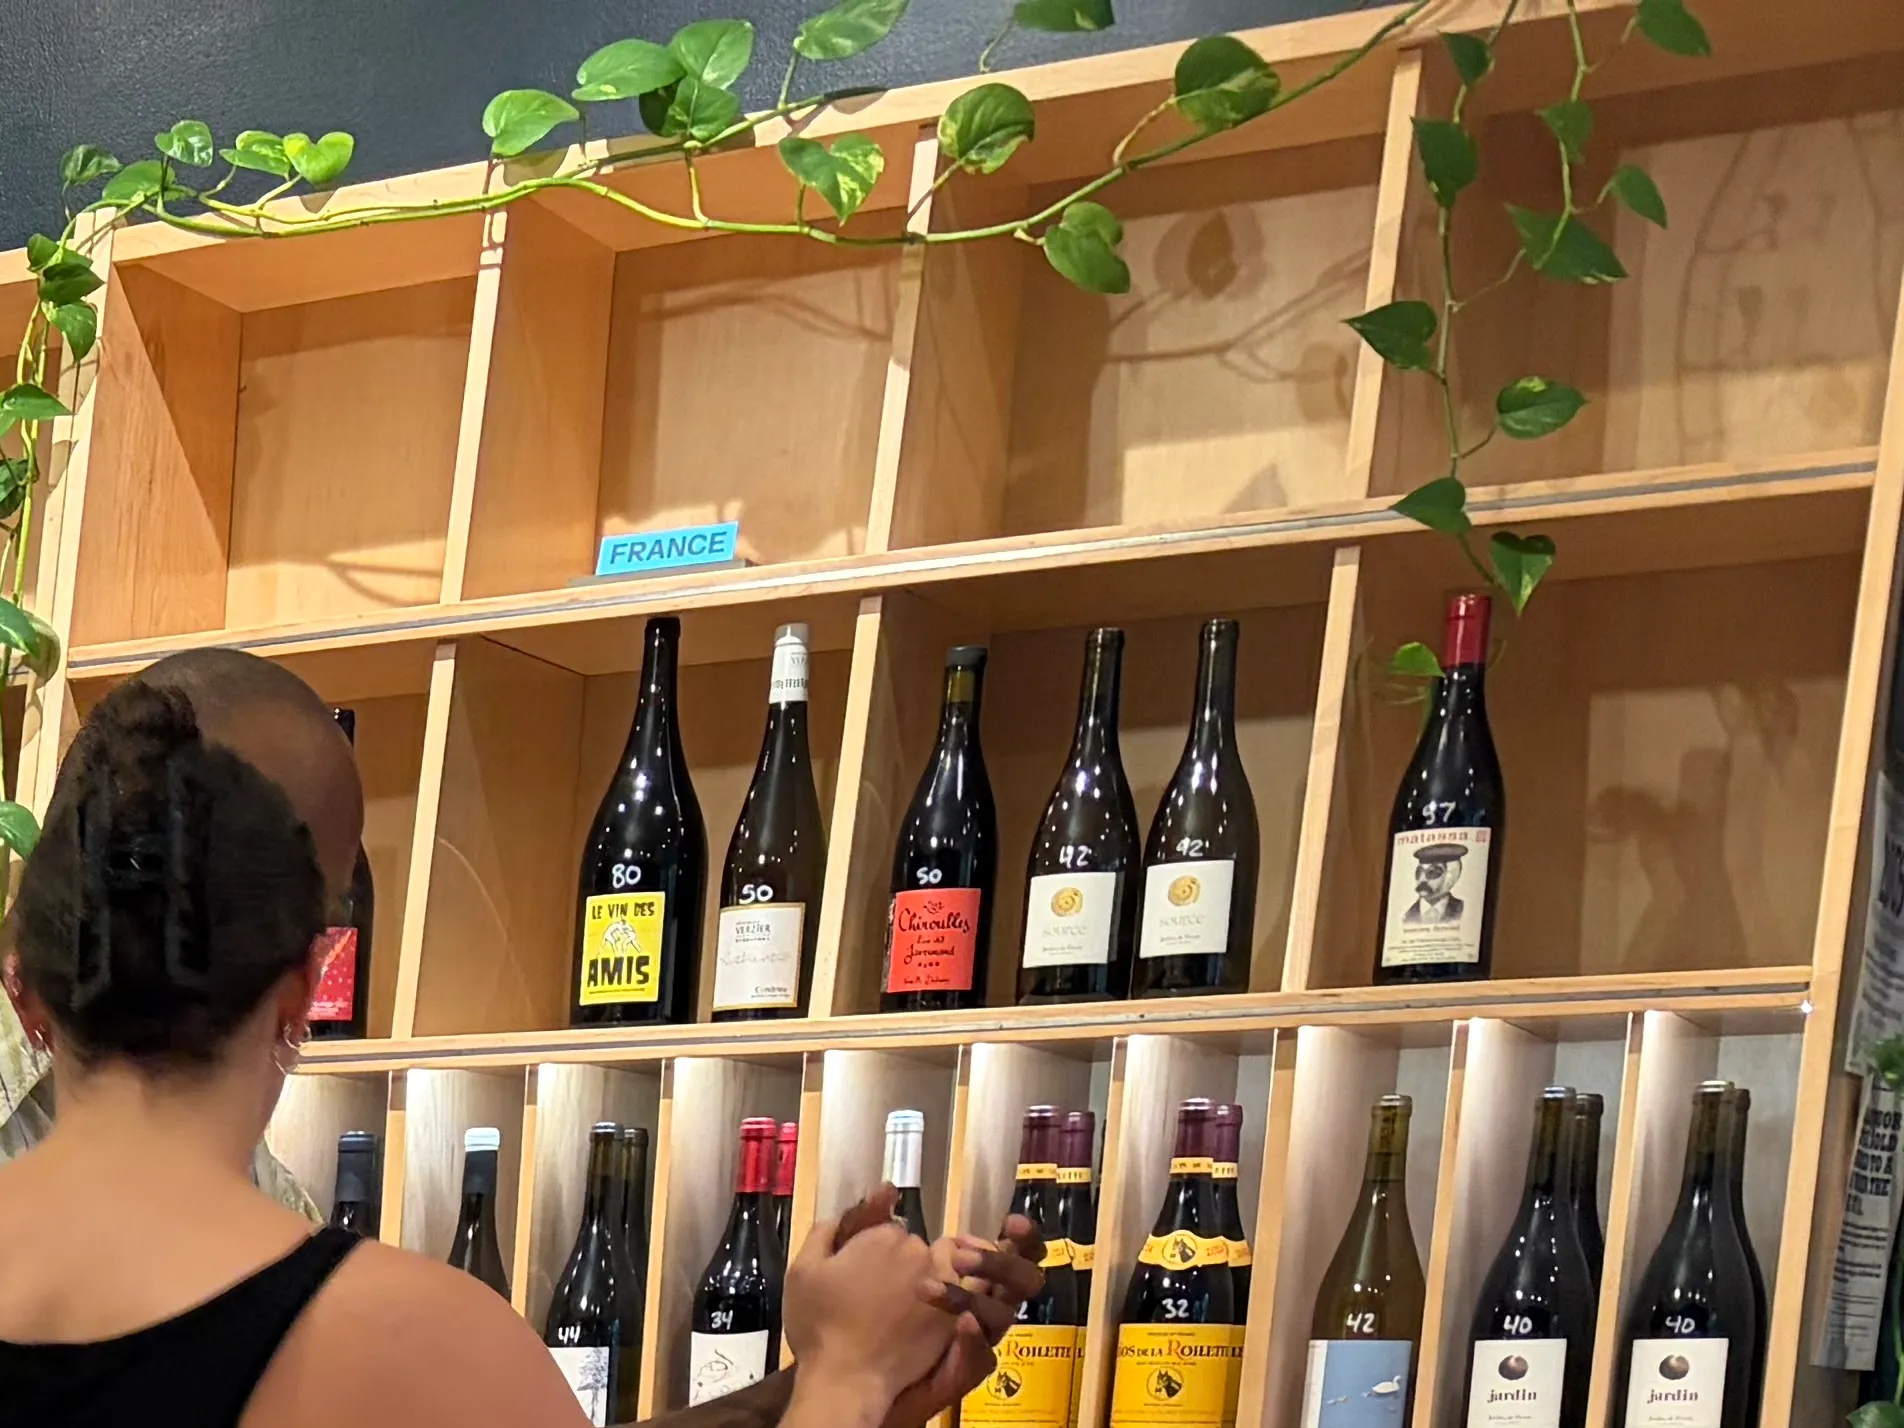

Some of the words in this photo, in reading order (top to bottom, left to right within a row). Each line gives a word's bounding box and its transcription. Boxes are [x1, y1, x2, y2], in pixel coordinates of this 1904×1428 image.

[609, 533, 727, 566] FRANCE
[1059, 845, 1092, 868] 42
[1176, 837, 1204, 857] 42
[612, 863, 642, 889] 80
[916, 866, 943, 885] 50
[739, 884, 774, 904] 50
[591, 905, 603, 920] LE
[608, 902, 629, 919] VIN
[633, 901, 655, 917] DES
[587, 956, 650, 988] AMIS
[1162, 1298, 1189, 1319] 32
[710, 1308, 733, 1330] 34
[1346, 1312, 1375, 1333] 42
[1503, 1314, 1533, 1334] 40
[1665, 1315, 1696, 1334] 40
[558, 1325, 581, 1344] 44
[1487, 1389, 1537, 1404] jardin
[1647, 1389, 1699, 1404] jardin
